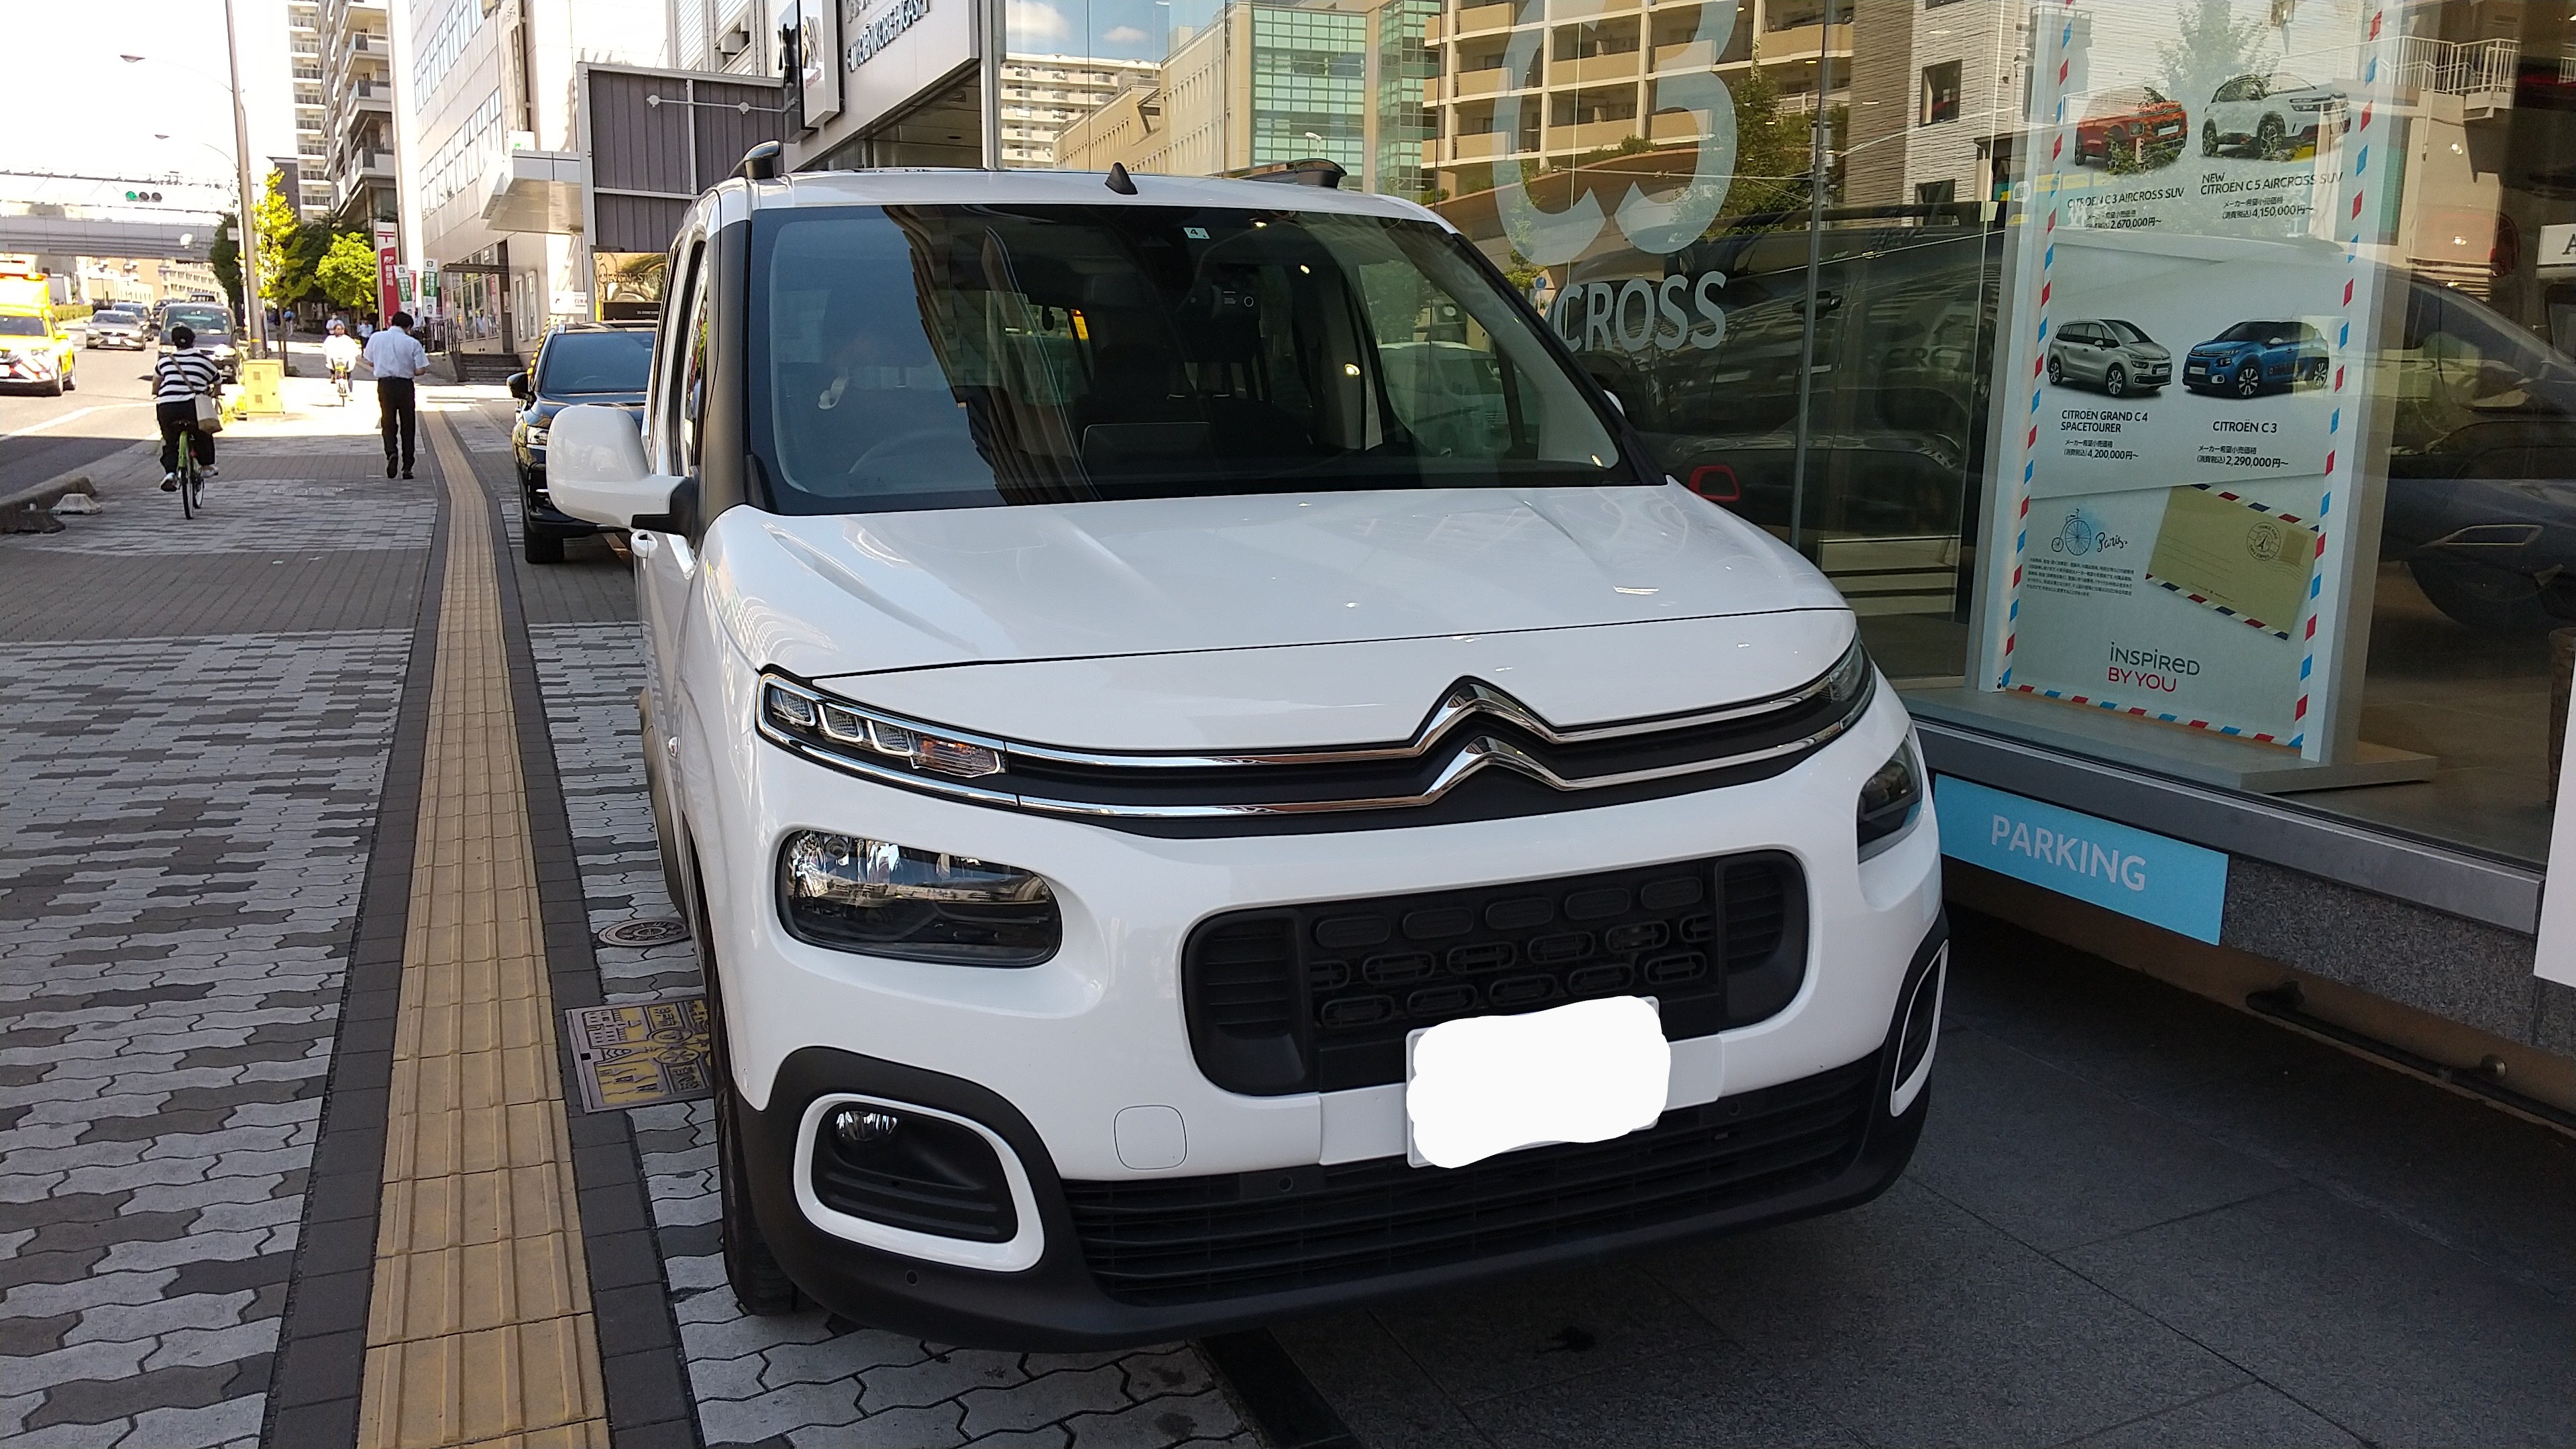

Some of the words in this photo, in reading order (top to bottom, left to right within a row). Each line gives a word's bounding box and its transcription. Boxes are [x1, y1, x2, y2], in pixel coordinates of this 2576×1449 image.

[2202, 172, 2225, 183] NEW
[2262, 174, 2315, 189] AIRCROSS
[2319, 172, 2343, 184] SUV
[2118, 189, 2163, 203] AIRCROSS
[2165, 187, 2185, 199] SUV
[1546, 270, 1727, 353] CROSS
[2100, 411, 2133, 421] GRAND
[2060, 421, 2121, 433] SPACETOURER
[2212, 419, 2259, 432] CITROËN
[2108, 666, 2133, 684] BY
[2134, 671, 2177, 692] YOU
[1991, 814, 2147, 892] PARKING
